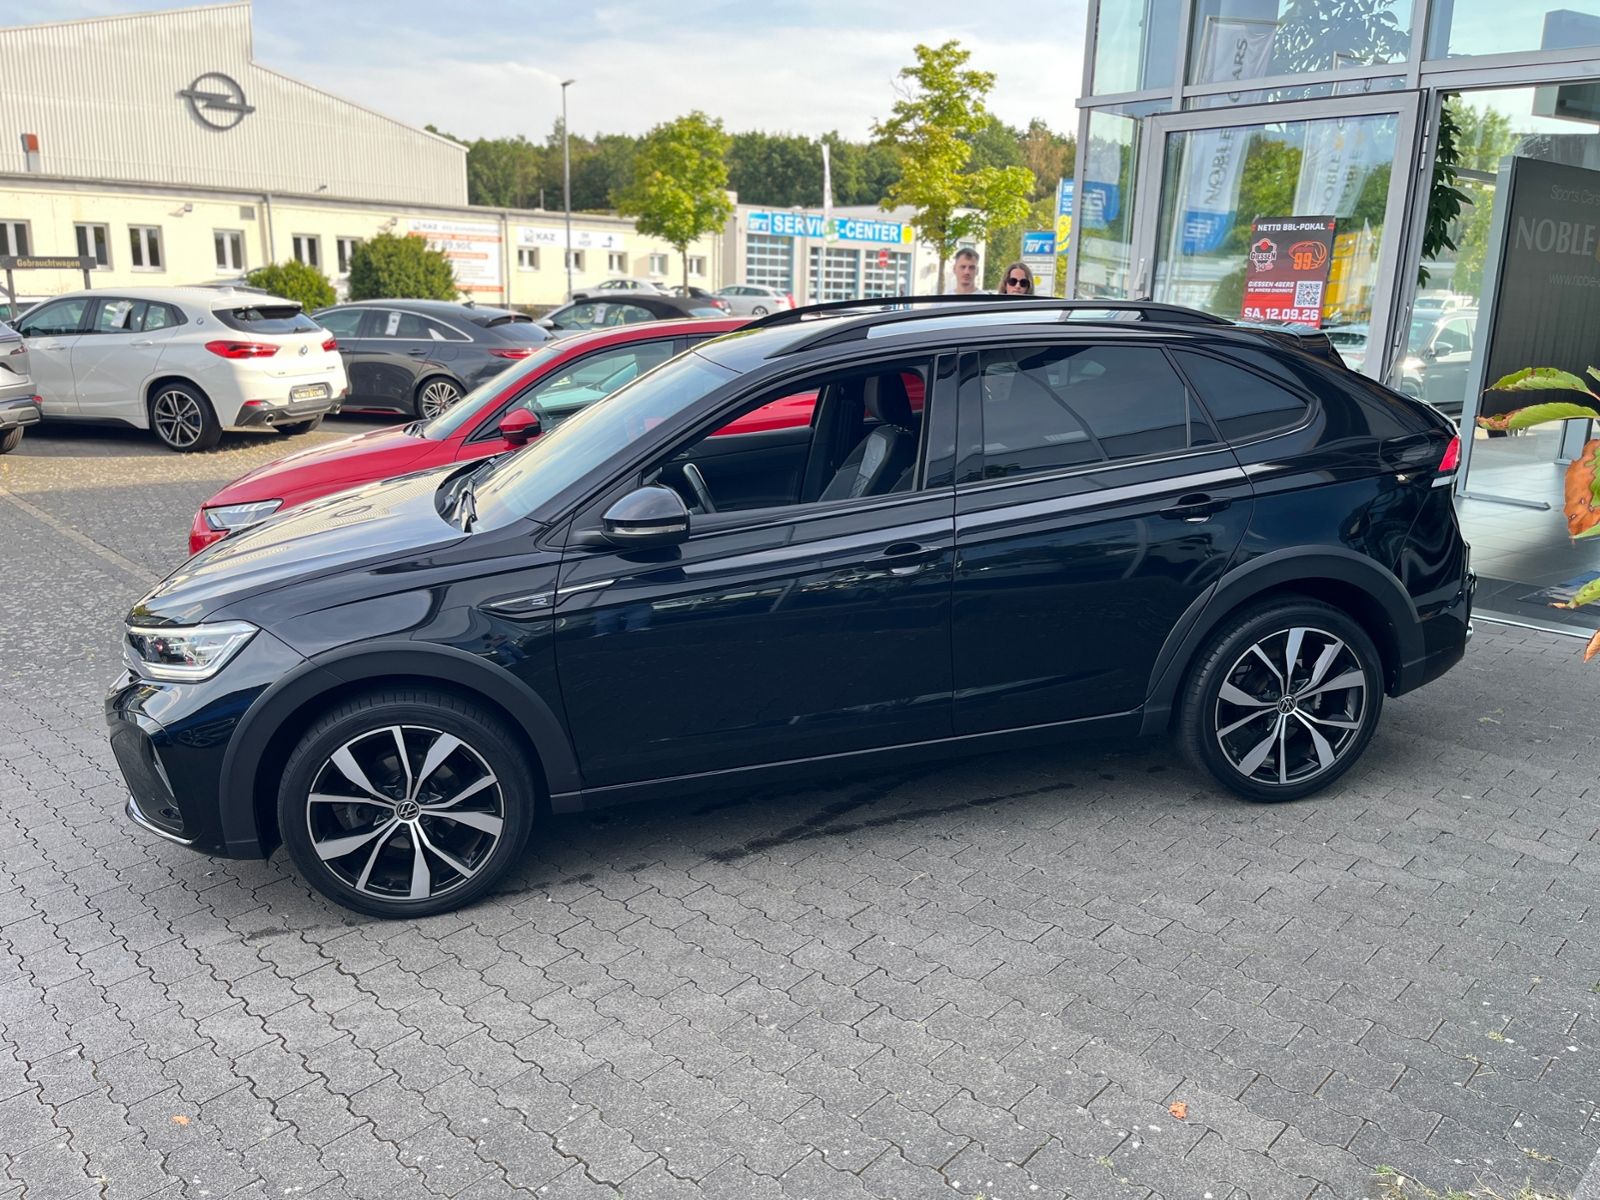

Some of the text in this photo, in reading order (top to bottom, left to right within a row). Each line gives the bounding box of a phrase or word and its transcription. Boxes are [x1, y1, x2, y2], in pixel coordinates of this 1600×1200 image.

[536, 233, 555, 241] KAZ
[1515, 216, 1596, 256] NOBLE
[1293, 253, 1313, 270] 99
[1265, 308, 1319, 321] 12.09.26
